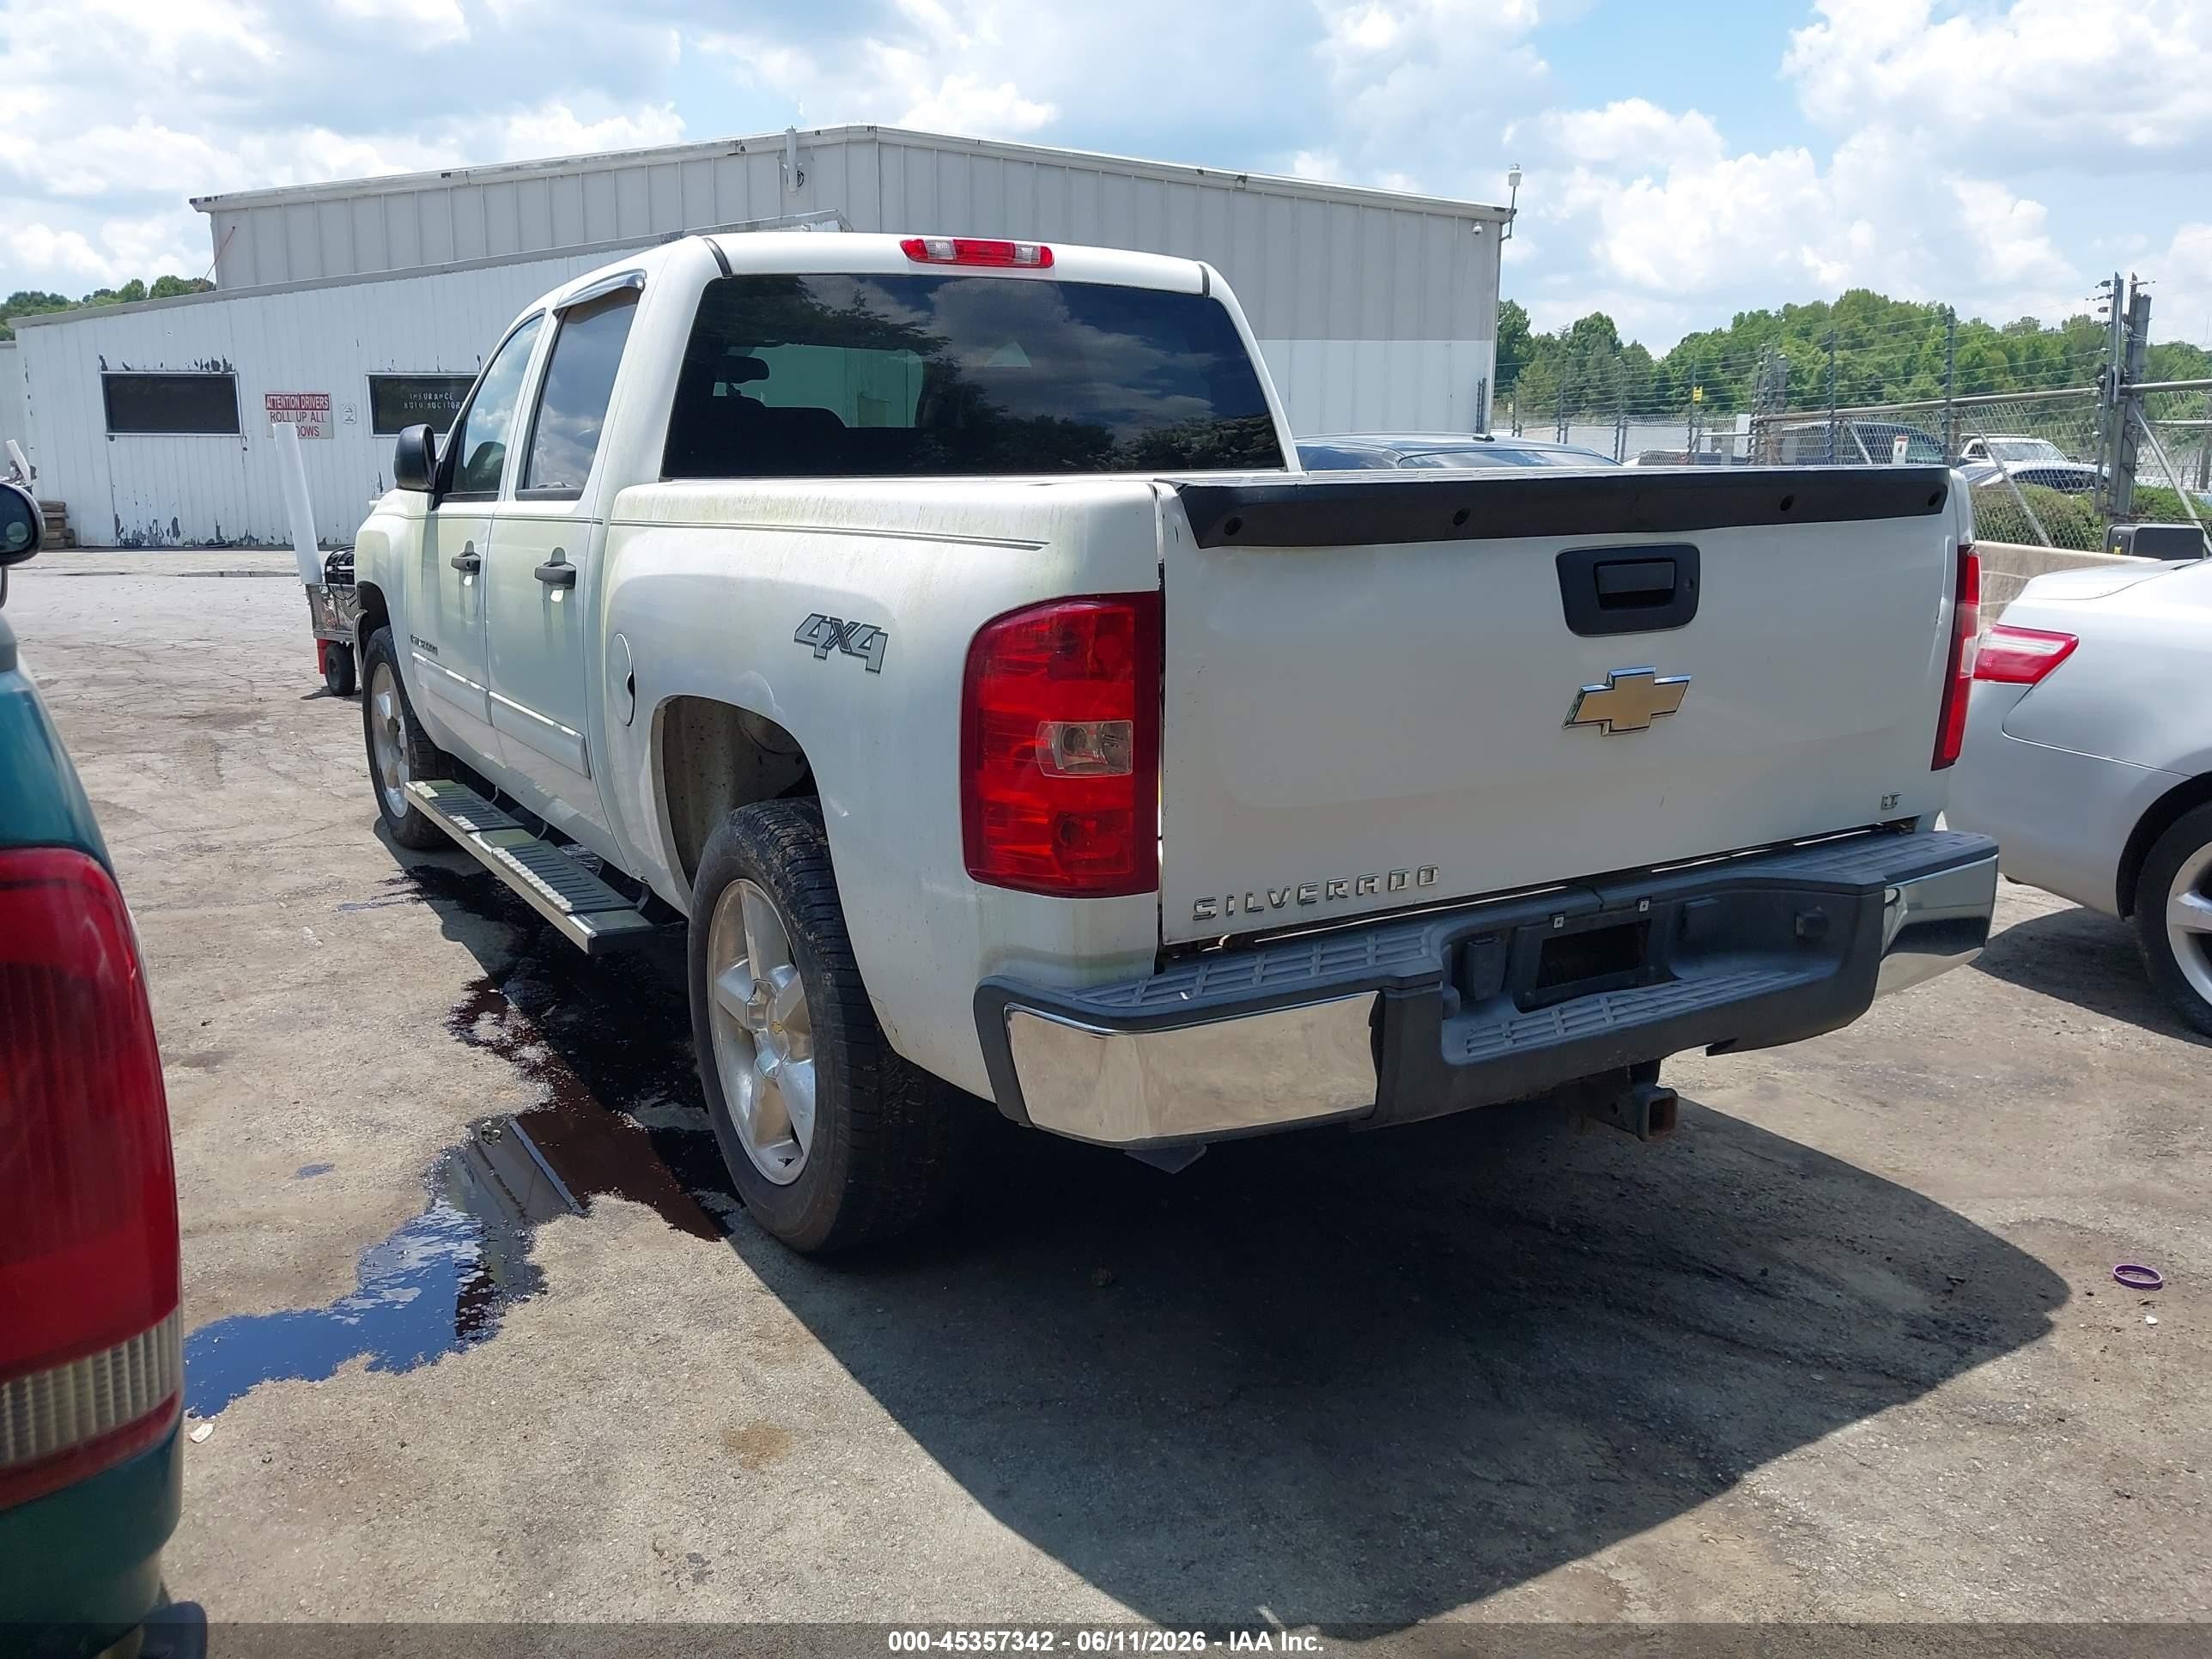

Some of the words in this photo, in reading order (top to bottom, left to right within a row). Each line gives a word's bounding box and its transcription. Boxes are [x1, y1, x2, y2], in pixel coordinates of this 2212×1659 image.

[266, 396, 298, 409] ATTENTION
[301, 396, 329, 410] DRIVERS
[270, 411, 294, 422] ROLL
[296, 412, 307, 422] UP
[310, 412, 328, 422] ALL
[295, 425, 320, 437] DOWS
[1881, 791, 1903, 811] LT
[1192, 864, 1440, 921] SILVERADO
